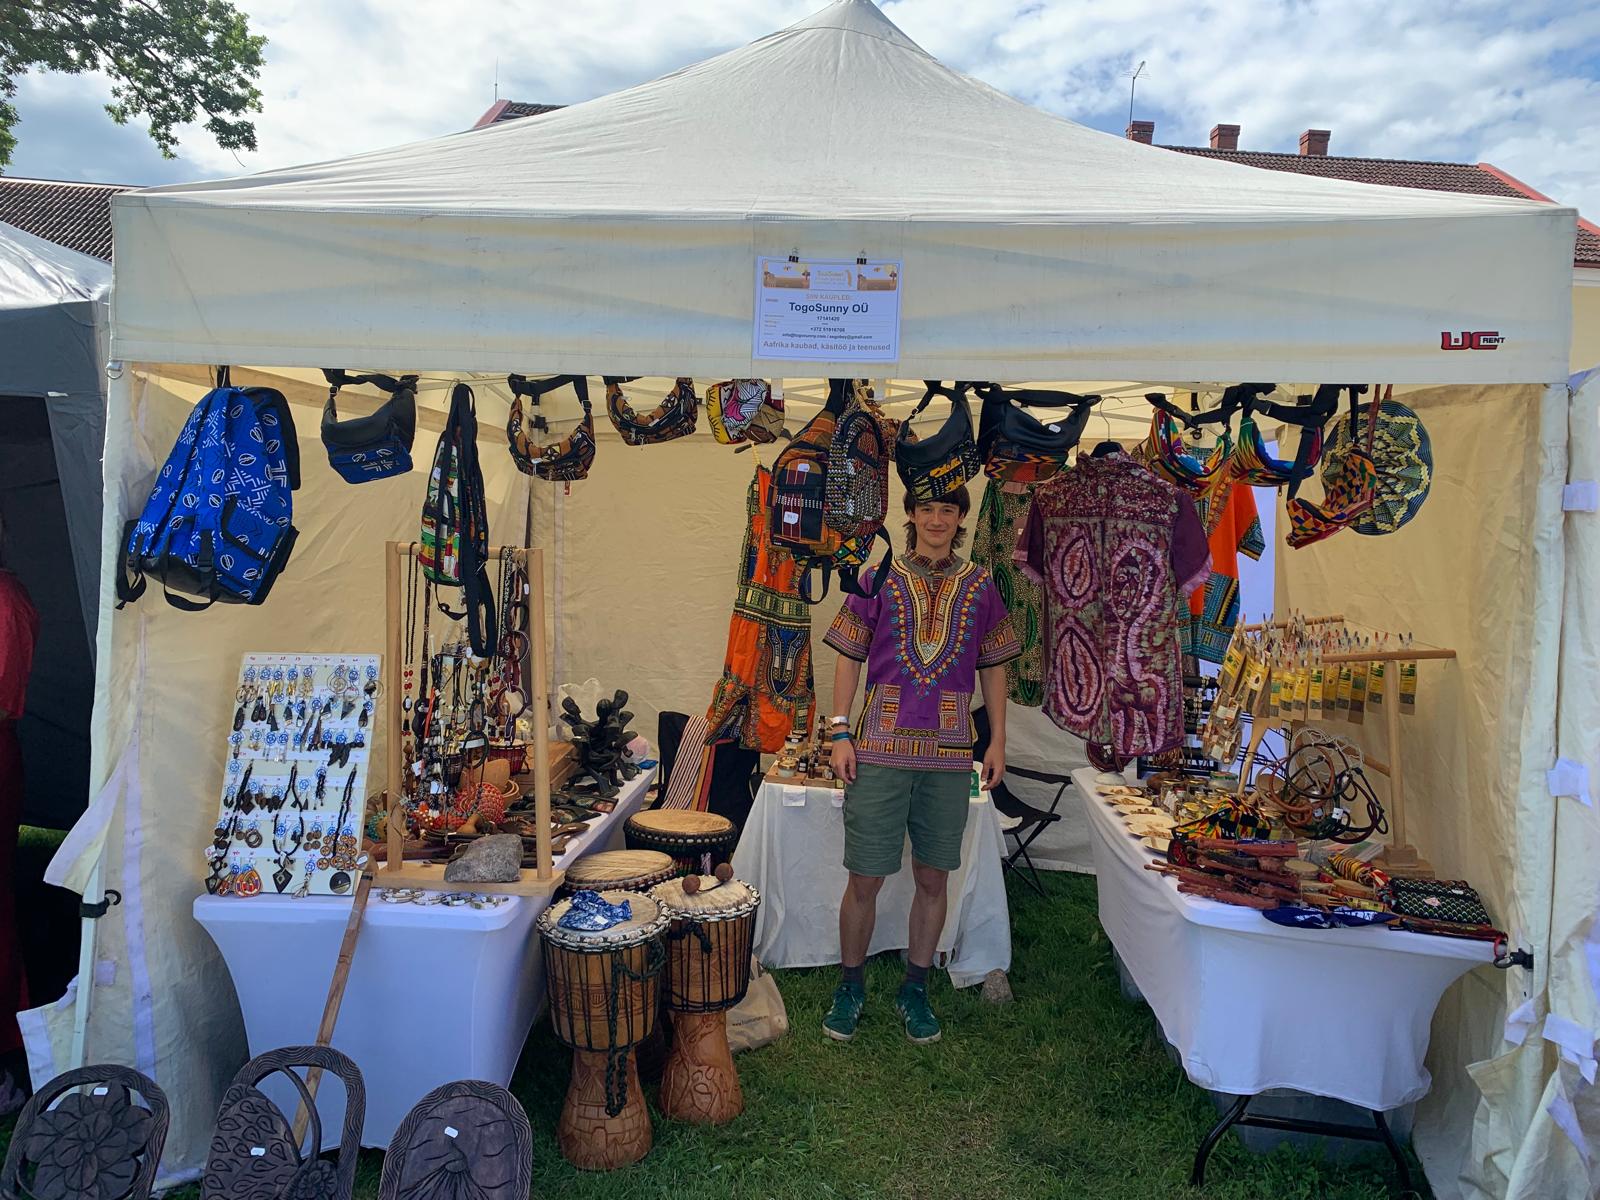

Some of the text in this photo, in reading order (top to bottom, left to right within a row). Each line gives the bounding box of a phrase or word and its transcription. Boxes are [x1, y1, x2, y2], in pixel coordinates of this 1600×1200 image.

[789, 302, 869, 315] TogoSunny OÜ
[764, 341, 788, 349] Aafrika
[791, 342, 819, 350] kaubad,
[849, 344, 855, 352] ja
